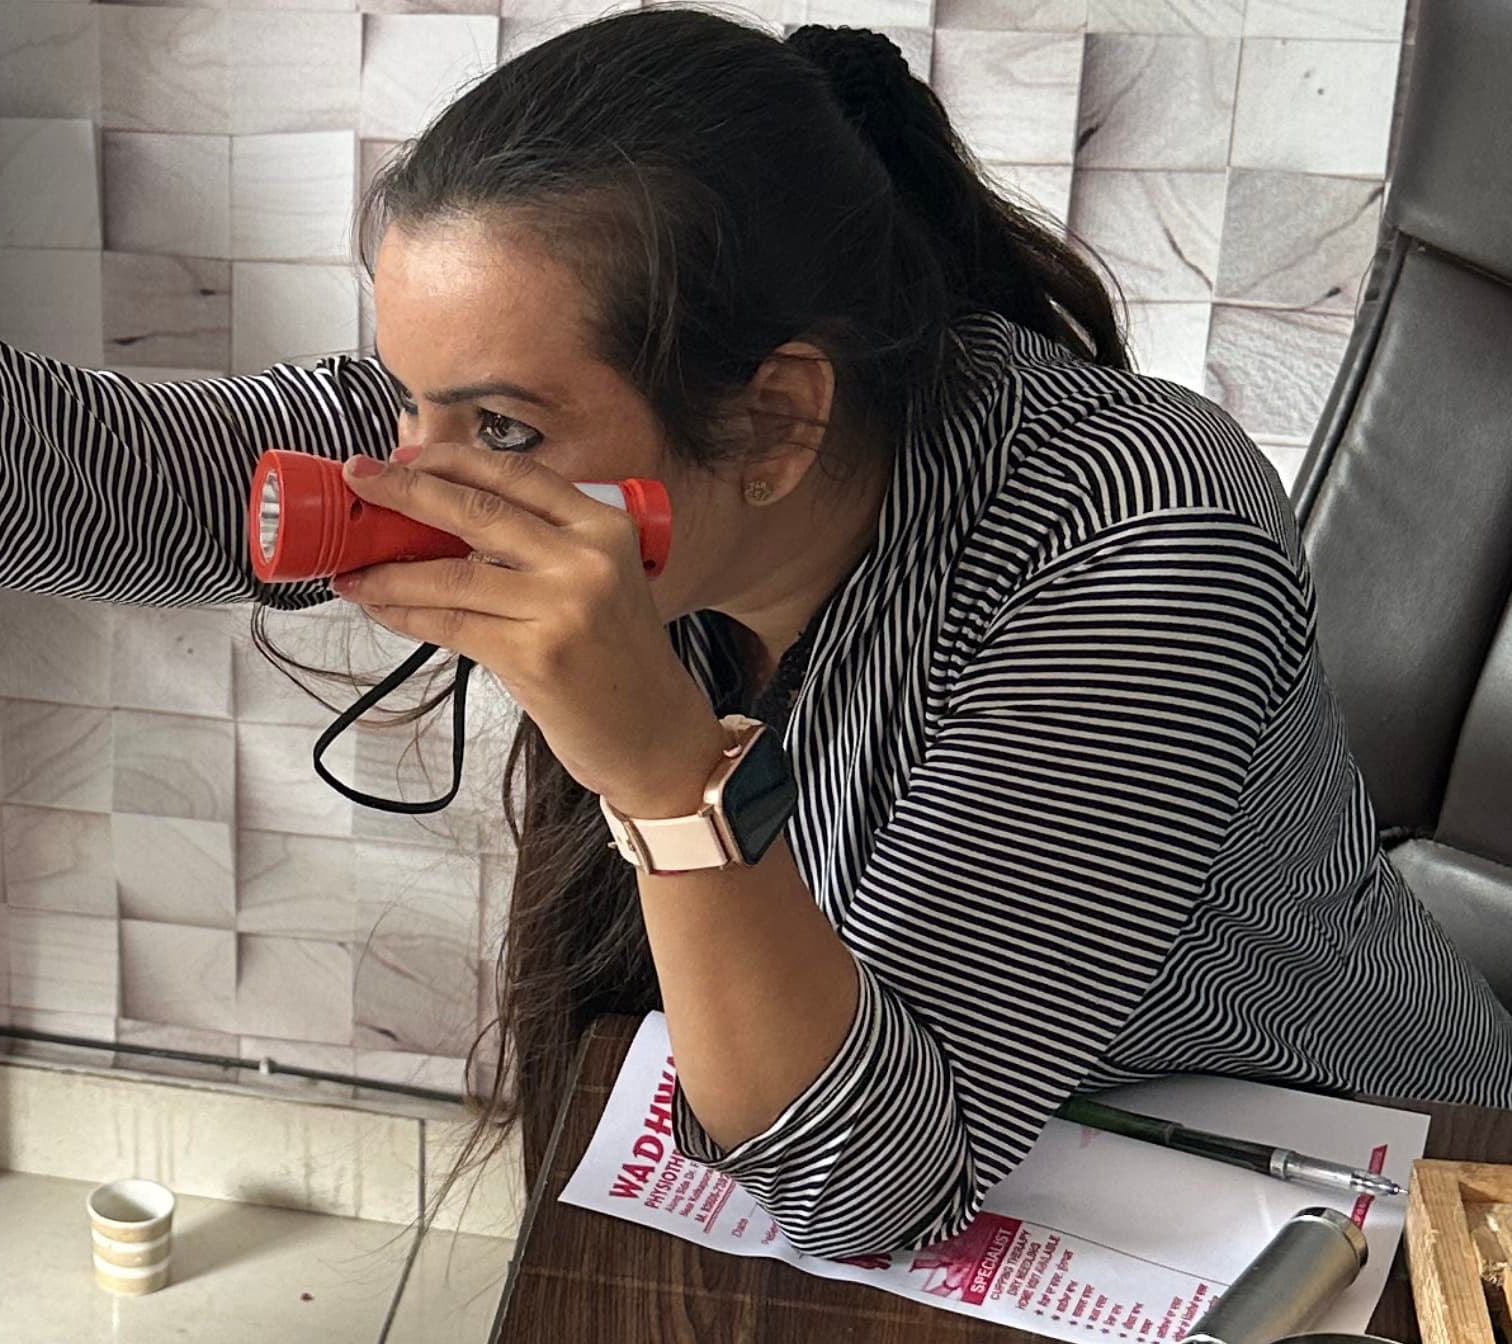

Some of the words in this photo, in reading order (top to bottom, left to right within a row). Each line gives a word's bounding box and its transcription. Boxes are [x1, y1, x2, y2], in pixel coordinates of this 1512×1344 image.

[731, 1217, 749, 1238] Date
[970, 1227, 1012, 1293] SPECIALIST
[990, 1266, 1014, 1300] CUPPING
[1007, 1228, 1031, 1265] THERAPY
[1007, 1278, 1022, 1296] DRY
[1015, 1241, 1042, 1279] NEEDLING
[1016, 1289, 1034, 1310] HOME
[1027, 1271, 1041, 1289] VISIT
[1035, 1234, 1061, 1275] AVAILABLE
